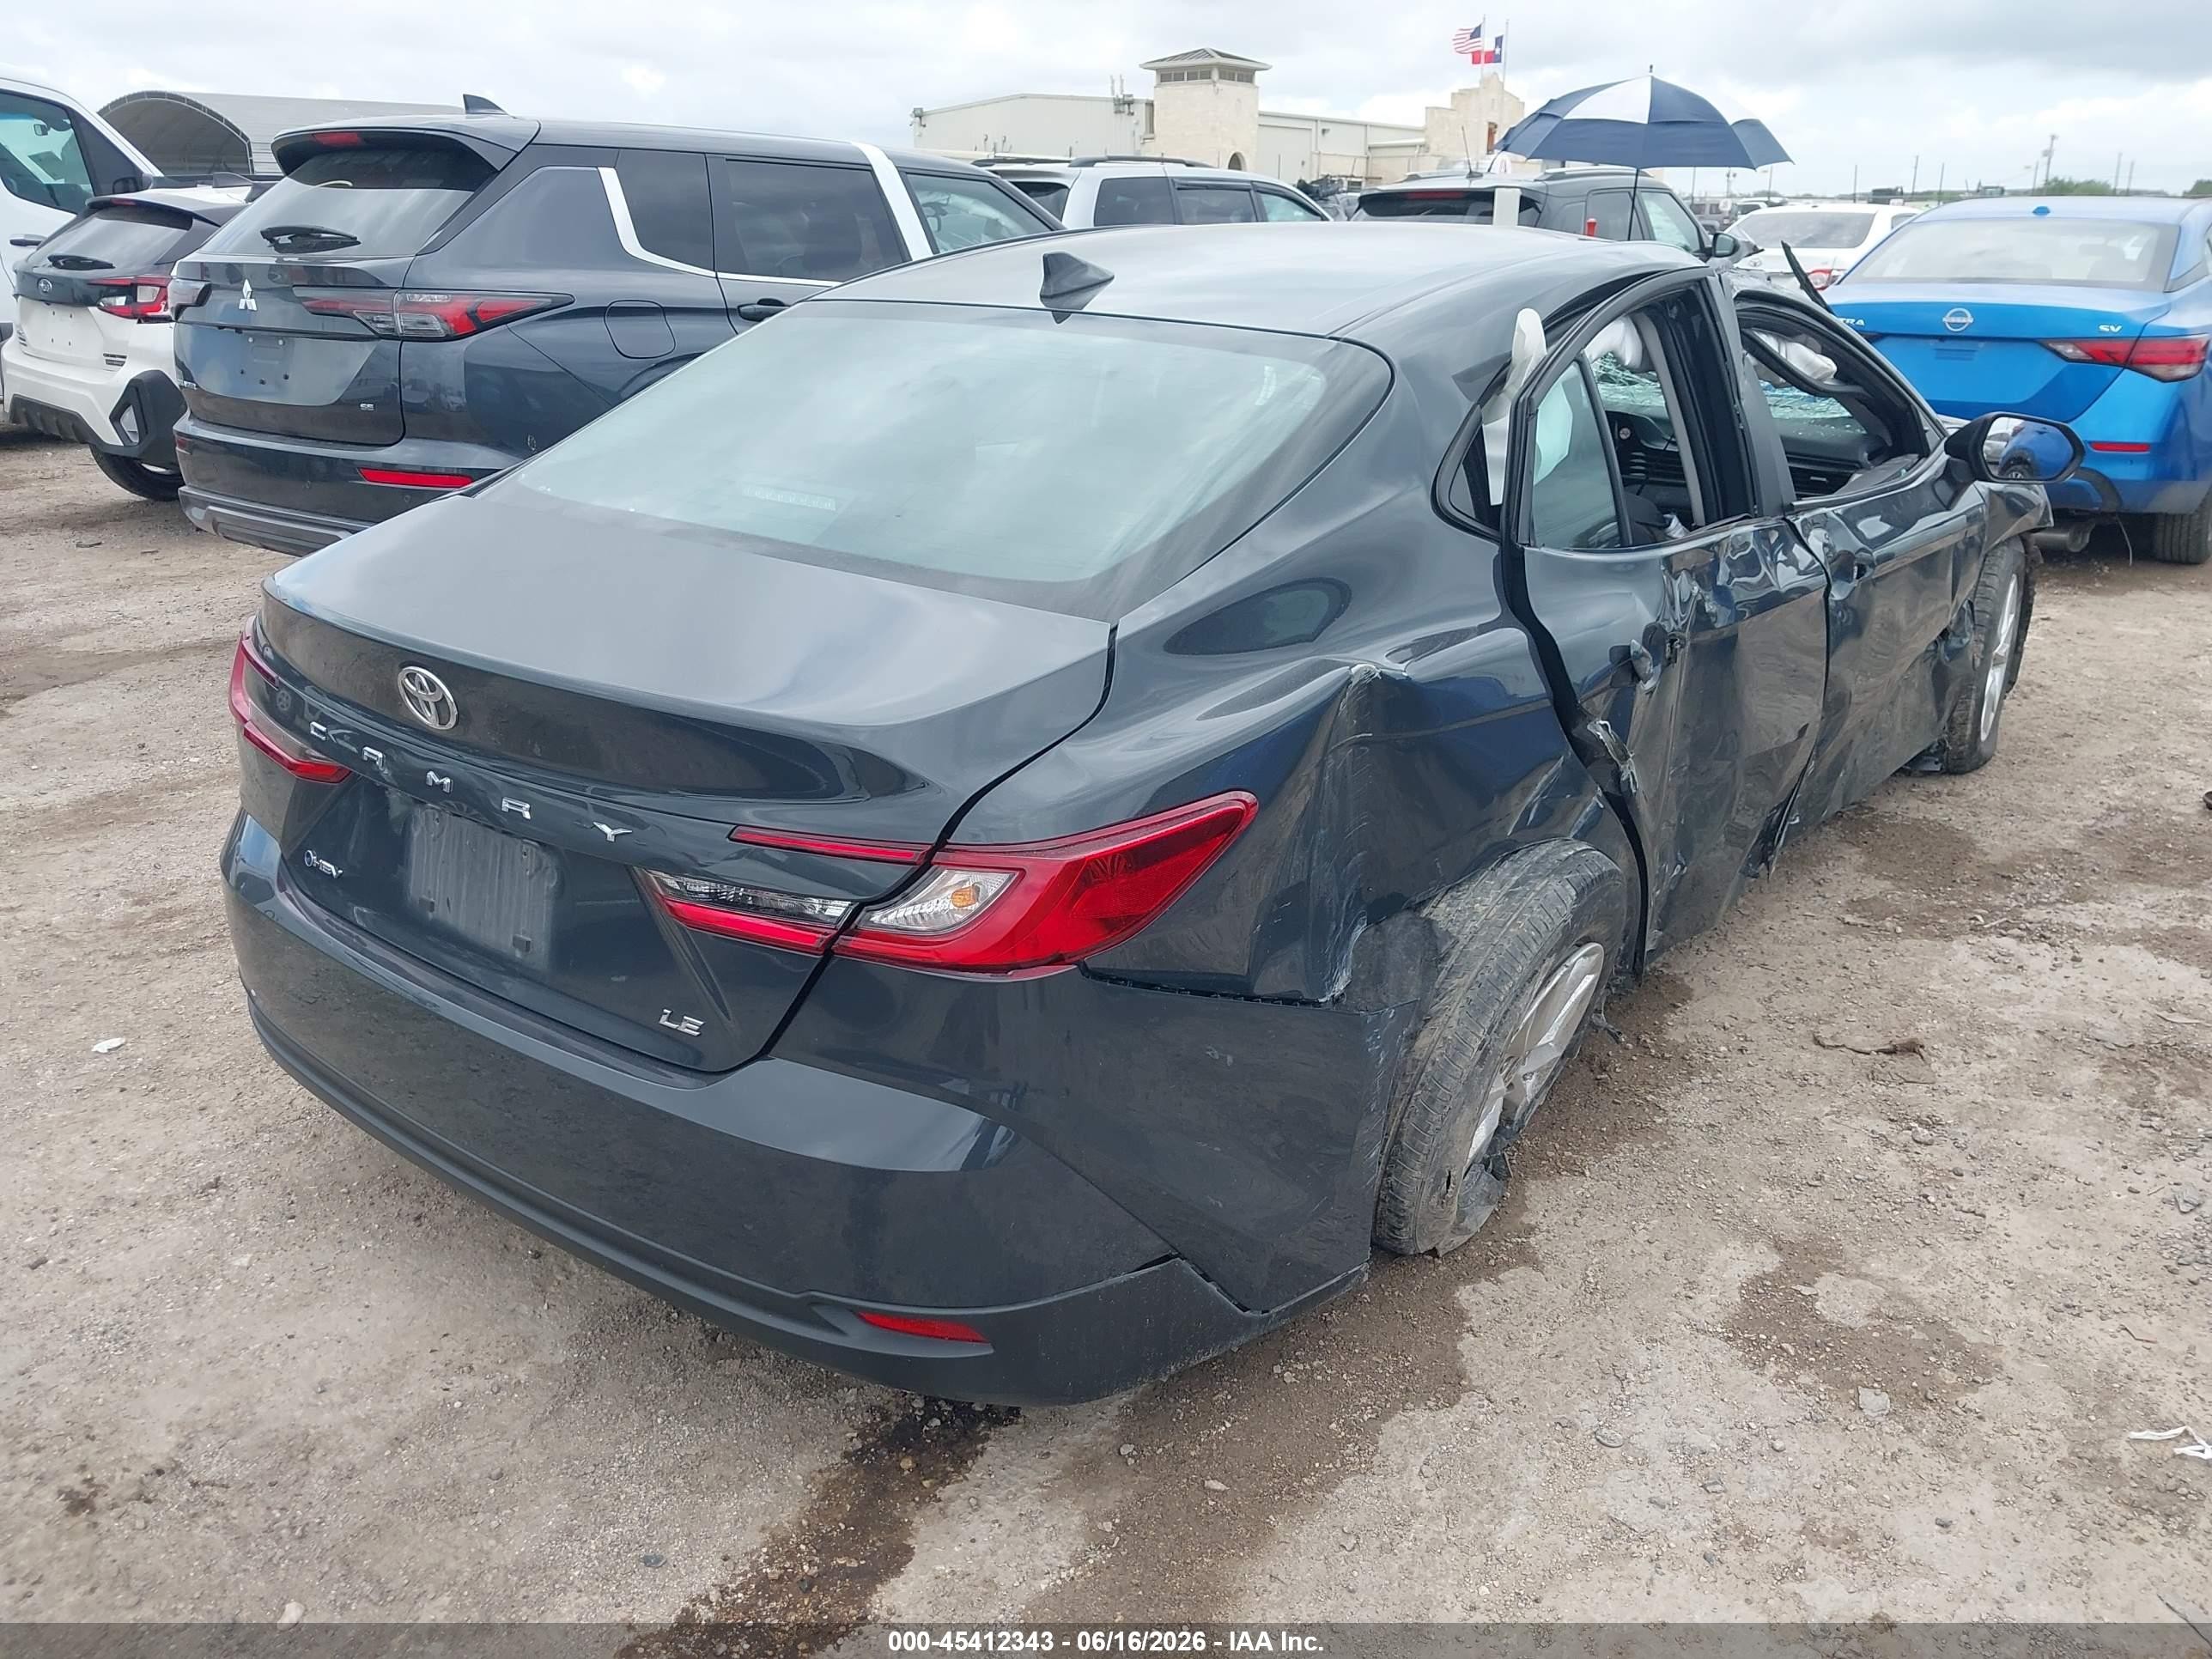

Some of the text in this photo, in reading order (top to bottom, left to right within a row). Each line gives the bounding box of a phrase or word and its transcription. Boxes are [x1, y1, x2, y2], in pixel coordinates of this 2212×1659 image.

[2099, 325, 2123, 333] SV
[309, 720, 633, 842] CAMRY
[659, 1009, 704, 1037] LE
